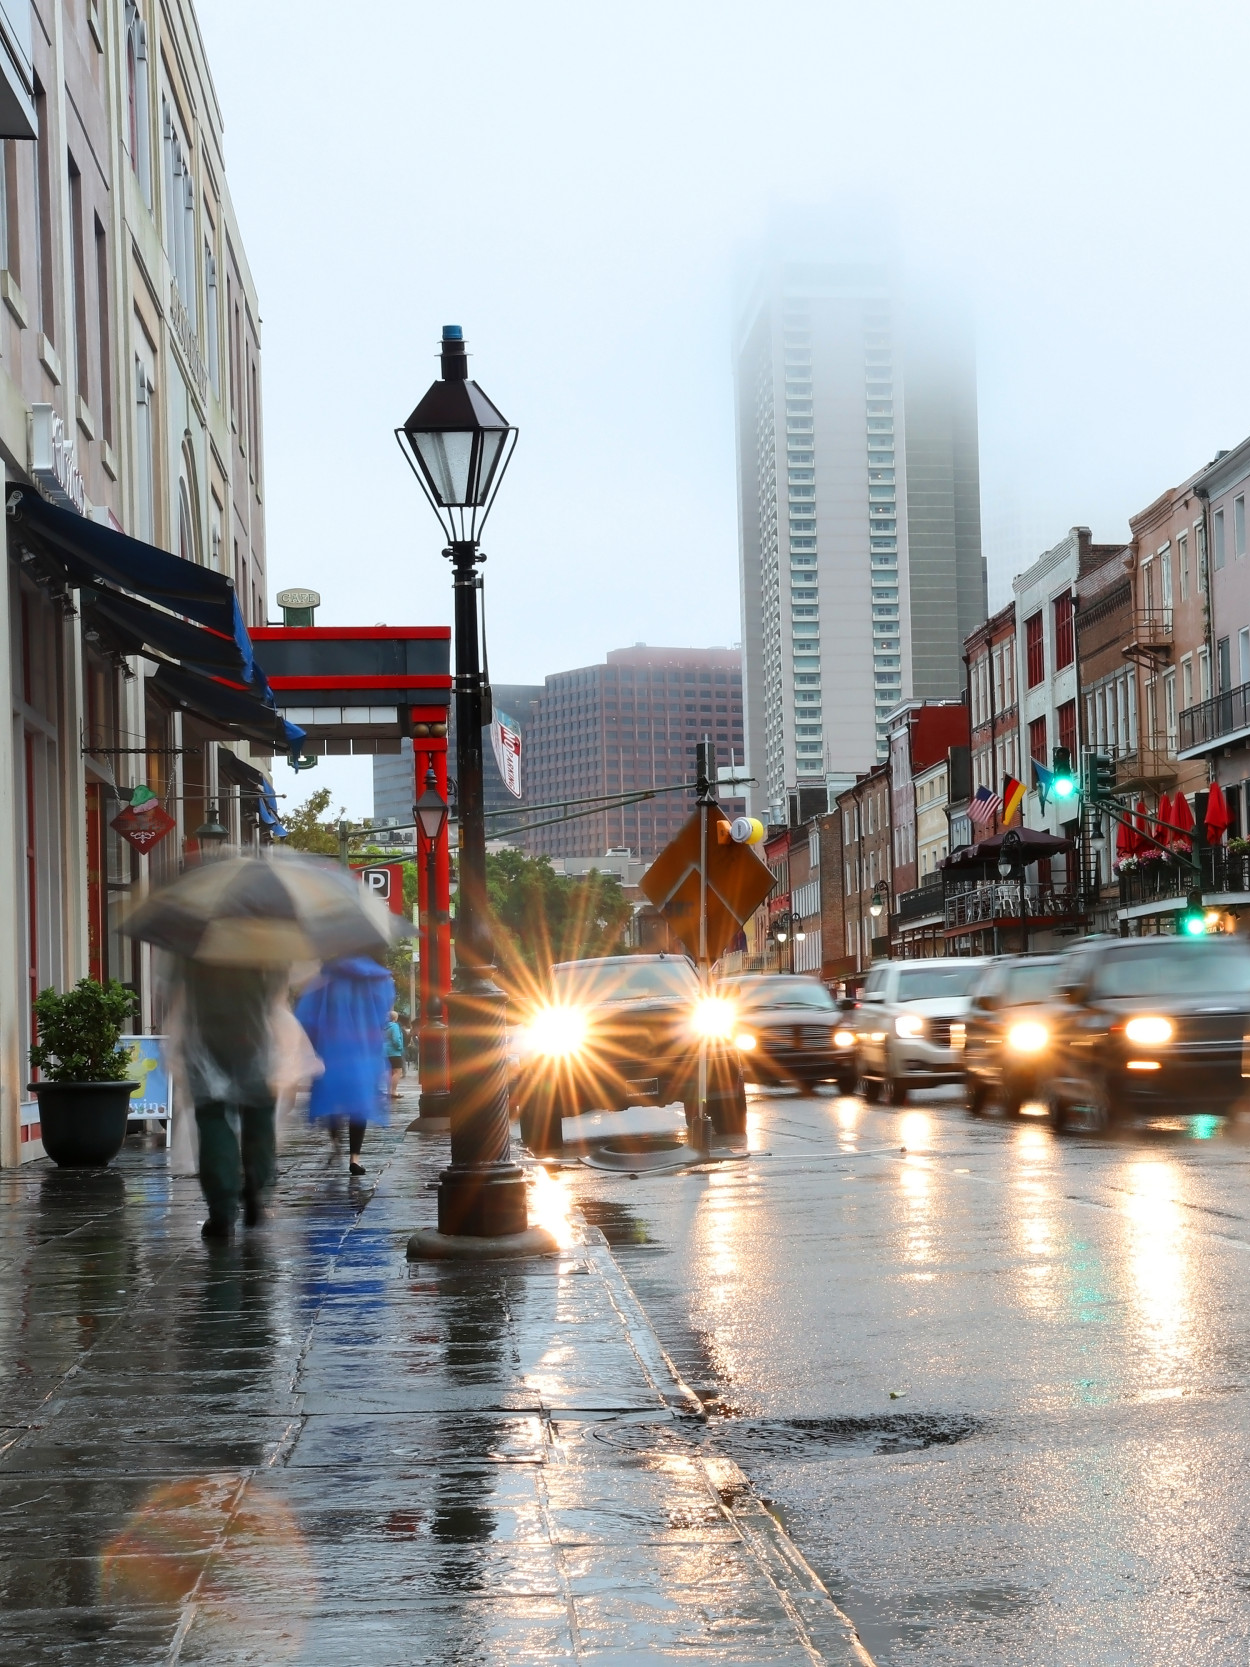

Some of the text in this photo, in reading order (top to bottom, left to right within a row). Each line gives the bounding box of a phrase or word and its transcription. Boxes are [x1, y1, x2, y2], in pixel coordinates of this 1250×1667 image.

[282, 593, 316, 603] CAFE
[503, 728, 516, 791] NO PARKING
[368, 873, 386, 895] P
